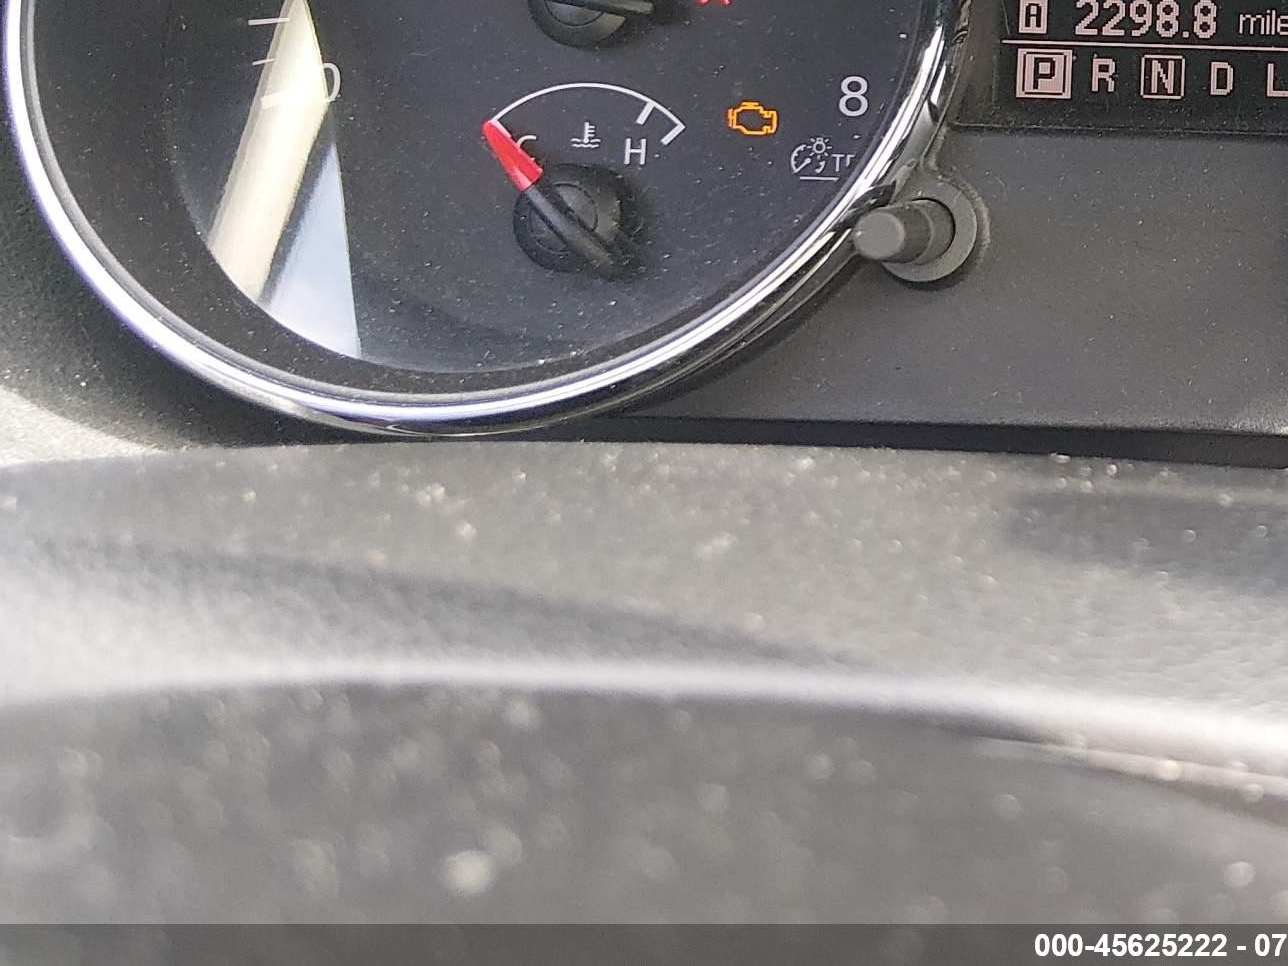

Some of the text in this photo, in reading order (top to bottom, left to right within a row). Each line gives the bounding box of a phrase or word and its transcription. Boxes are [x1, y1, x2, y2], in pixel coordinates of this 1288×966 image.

[1091, 58, 1116, 92] R
[1150, 60, 1175, 94] N
[1210, 62, 1234, 96] D
[839, 76, 869, 117] 8
[624, 138, 647, 165] H
